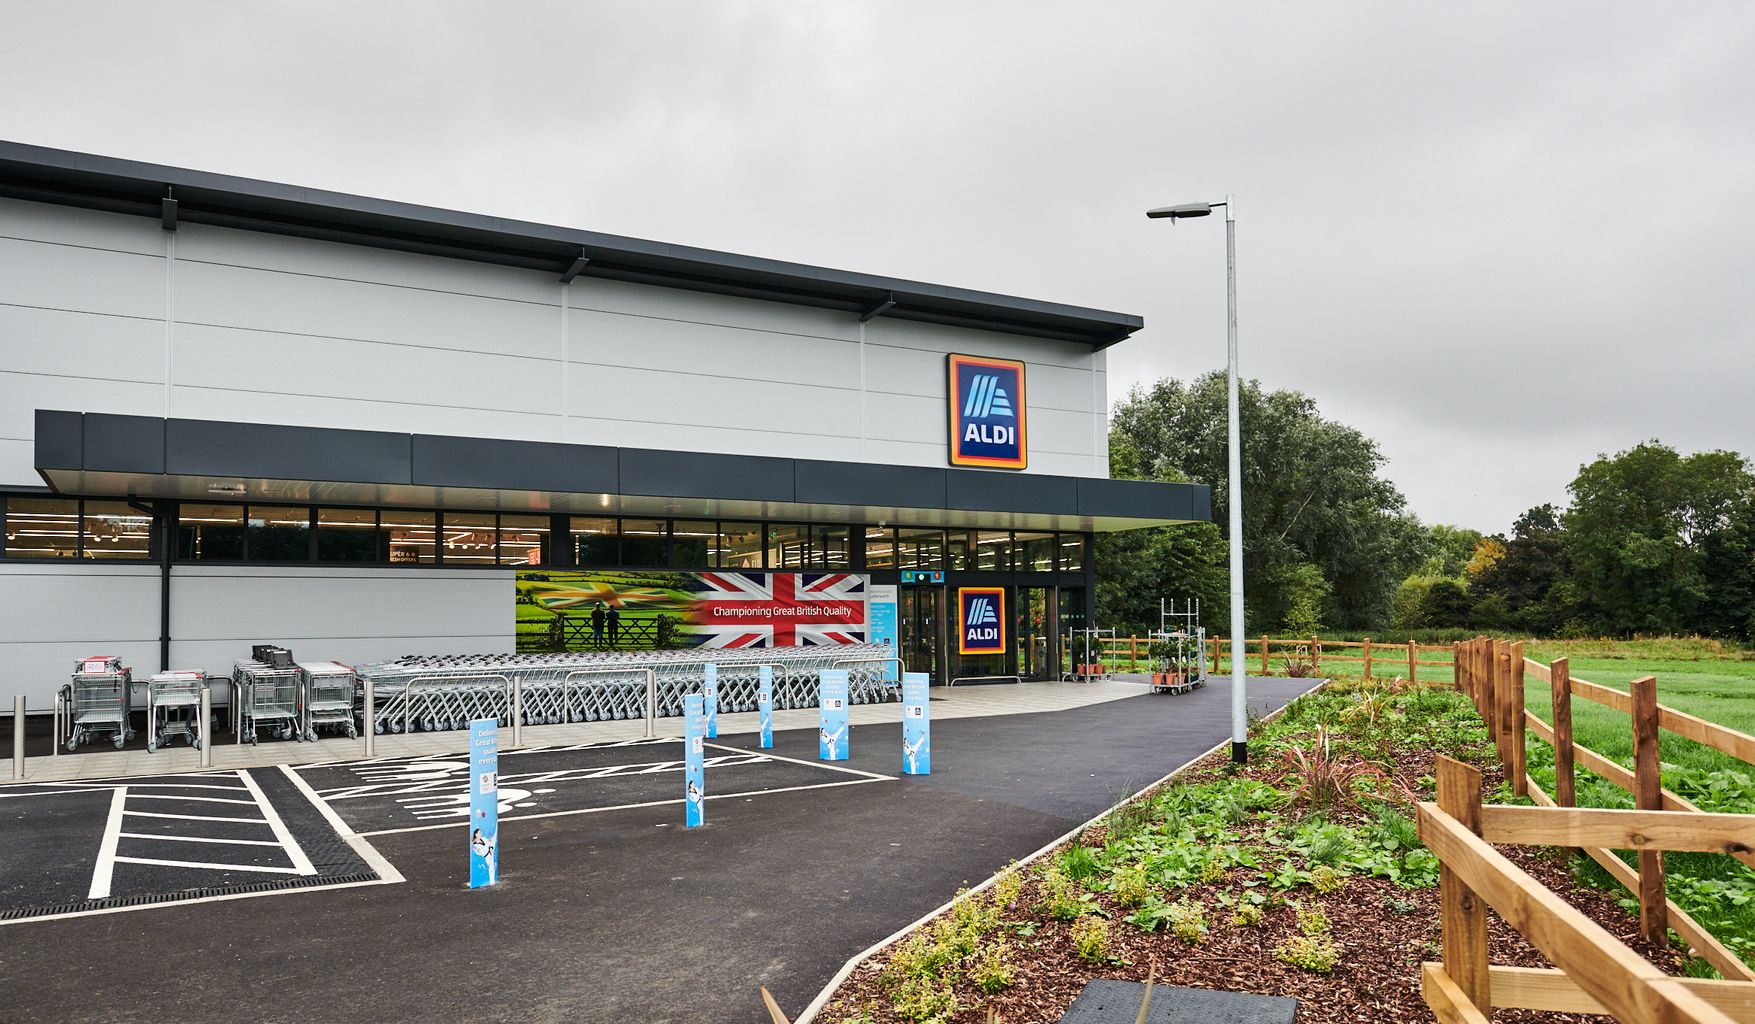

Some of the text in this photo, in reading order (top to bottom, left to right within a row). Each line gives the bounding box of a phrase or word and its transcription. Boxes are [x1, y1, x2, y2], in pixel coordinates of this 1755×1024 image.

[964, 423, 1014, 445] ALDI
[713, 605, 852, 618] Championing Great British Quality
[967, 628, 998, 641] ALDI
